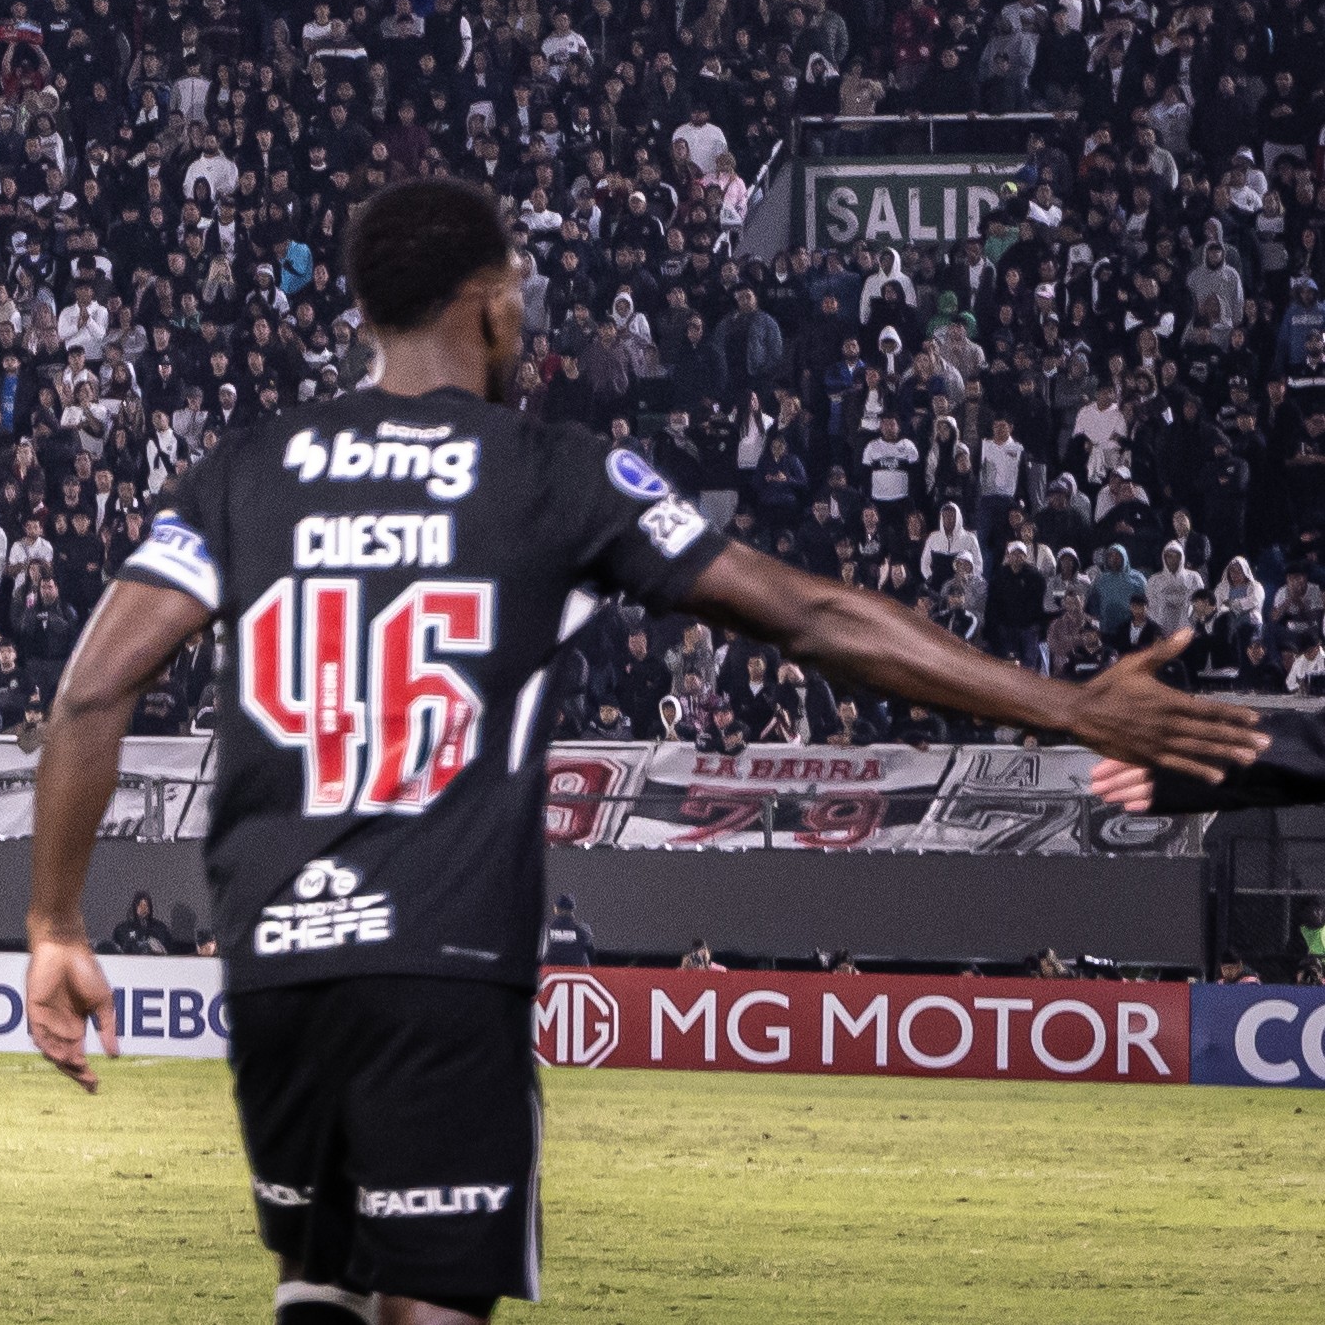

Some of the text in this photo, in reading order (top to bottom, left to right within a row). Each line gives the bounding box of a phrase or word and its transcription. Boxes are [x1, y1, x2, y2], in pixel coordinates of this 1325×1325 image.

[825, 185, 1001, 244] SALID
[329, 438, 479, 500] bmg
[294, 513, 457, 568] CUESTA
[239, 576, 497, 817] 46
[255, 908, 391, 955] CHEFE
[649, 988, 791, 1064] MG
[821, 992, 1172, 1076] MOTOR
[367, 1185, 511, 1218] FACILITY
